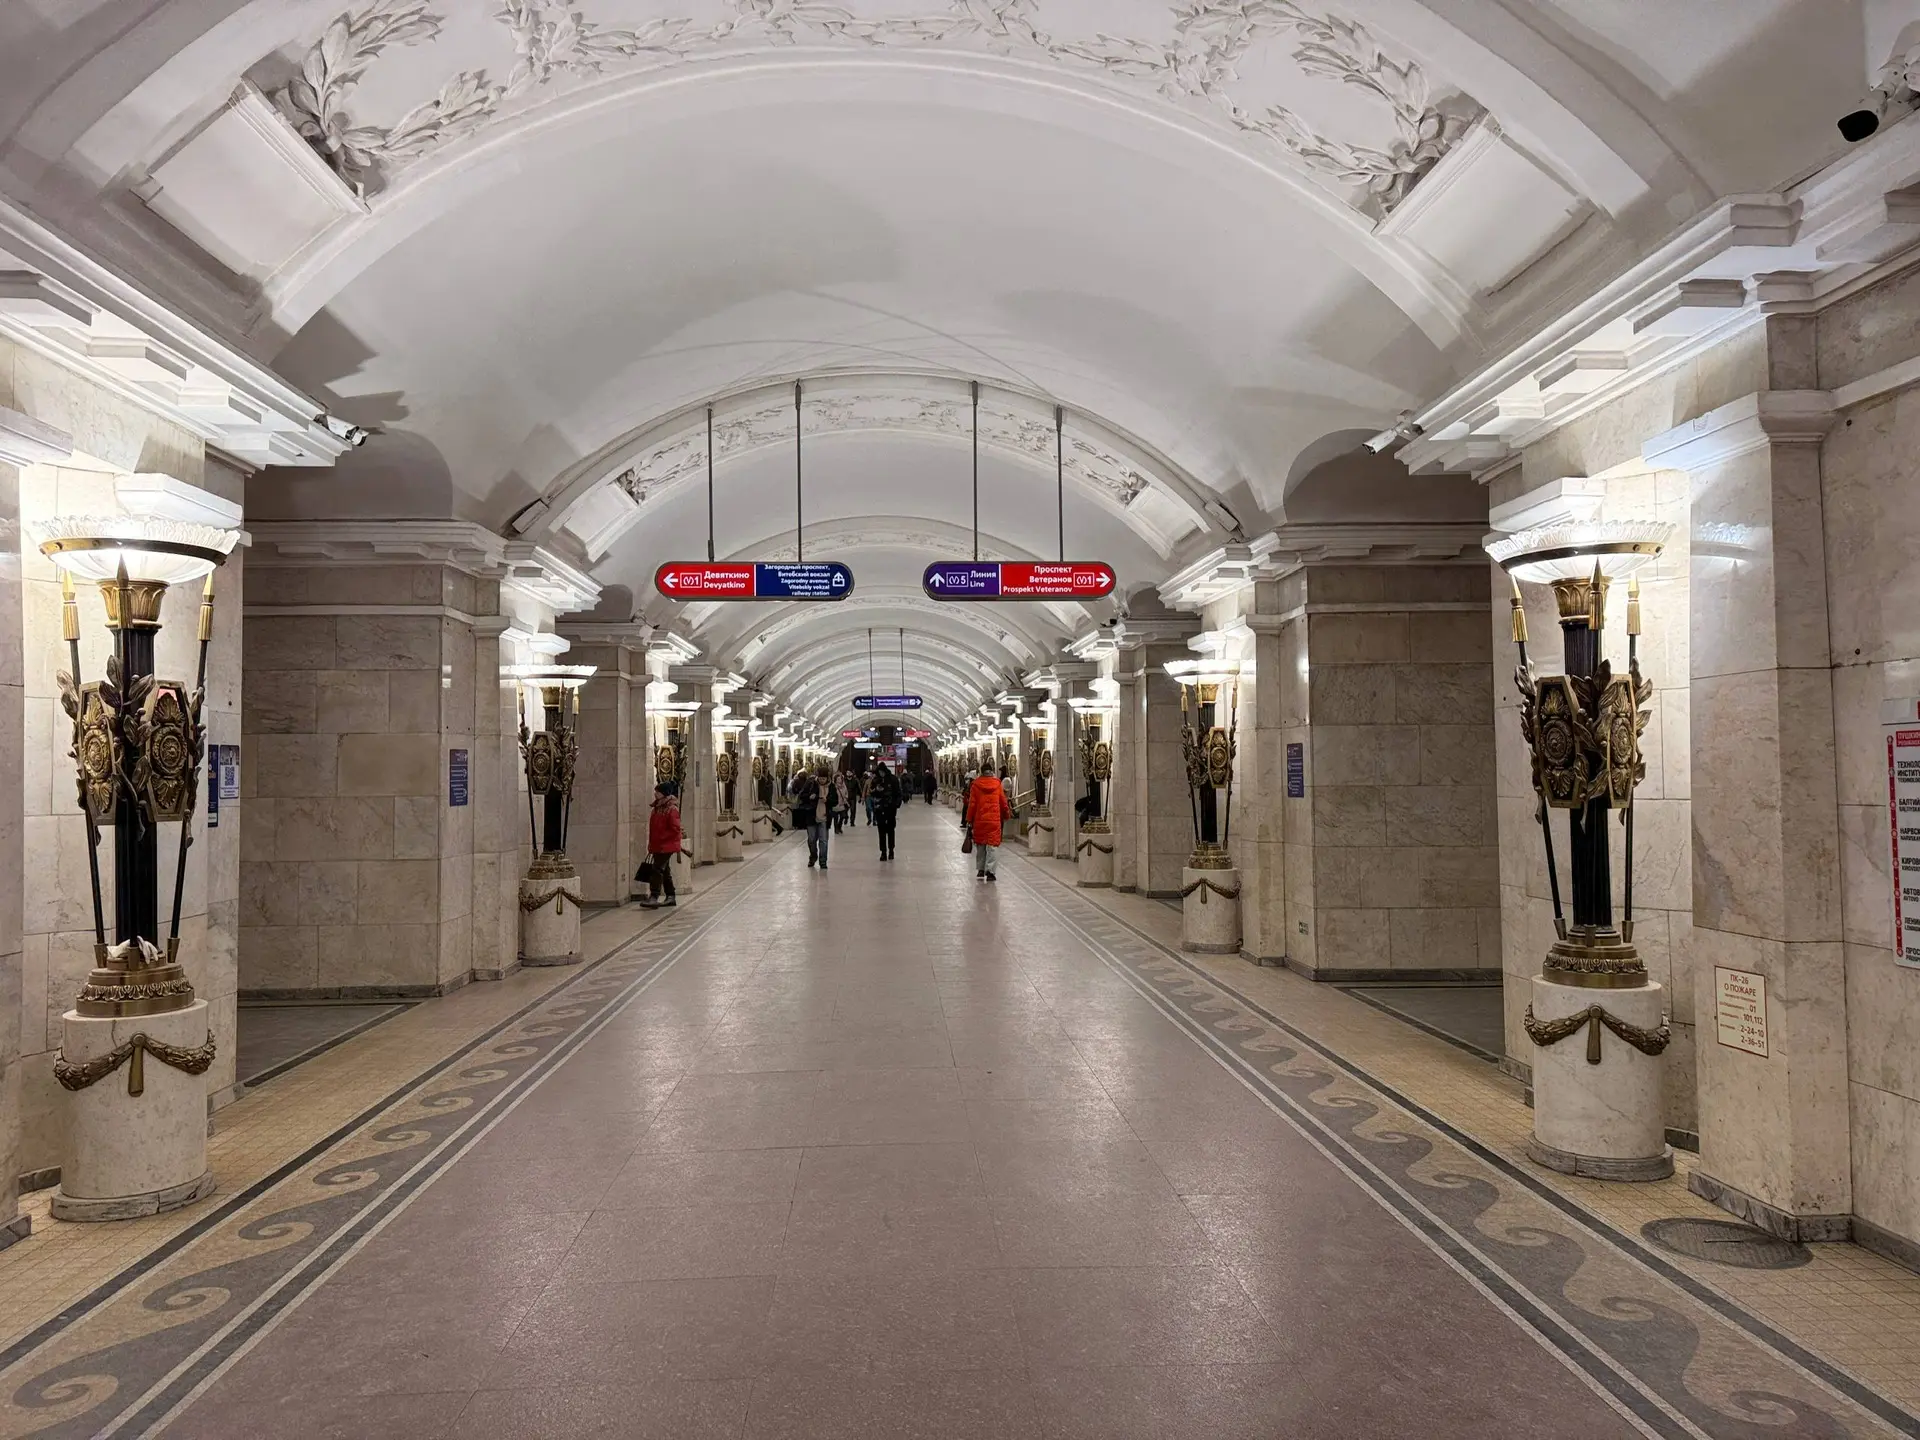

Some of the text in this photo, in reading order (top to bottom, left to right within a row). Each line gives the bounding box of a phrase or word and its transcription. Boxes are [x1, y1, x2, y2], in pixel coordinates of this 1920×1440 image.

[970, 570, 997, 578] Линия
[1034, 565, 1073, 575] Проспект
[703, 570, 750, 580] Девяткино
[1029, 575, 1073, 584] Ветеранов
[703, 581, 746, 590] Devyatkino
[780, 577, 809, 585] Zagorodny
[970, 580, 985, 588] Line
[1002, 585, 1073, 594] Prospekt Veteranov
[1730, 974, 1749, 984] ПК-26
[1724, 983, 1757, 997] О ПОЖАРЕ
[1750, 1004, 1756, 1013] 01
[1740, 1025, 1764, 1038] 2-24-10
